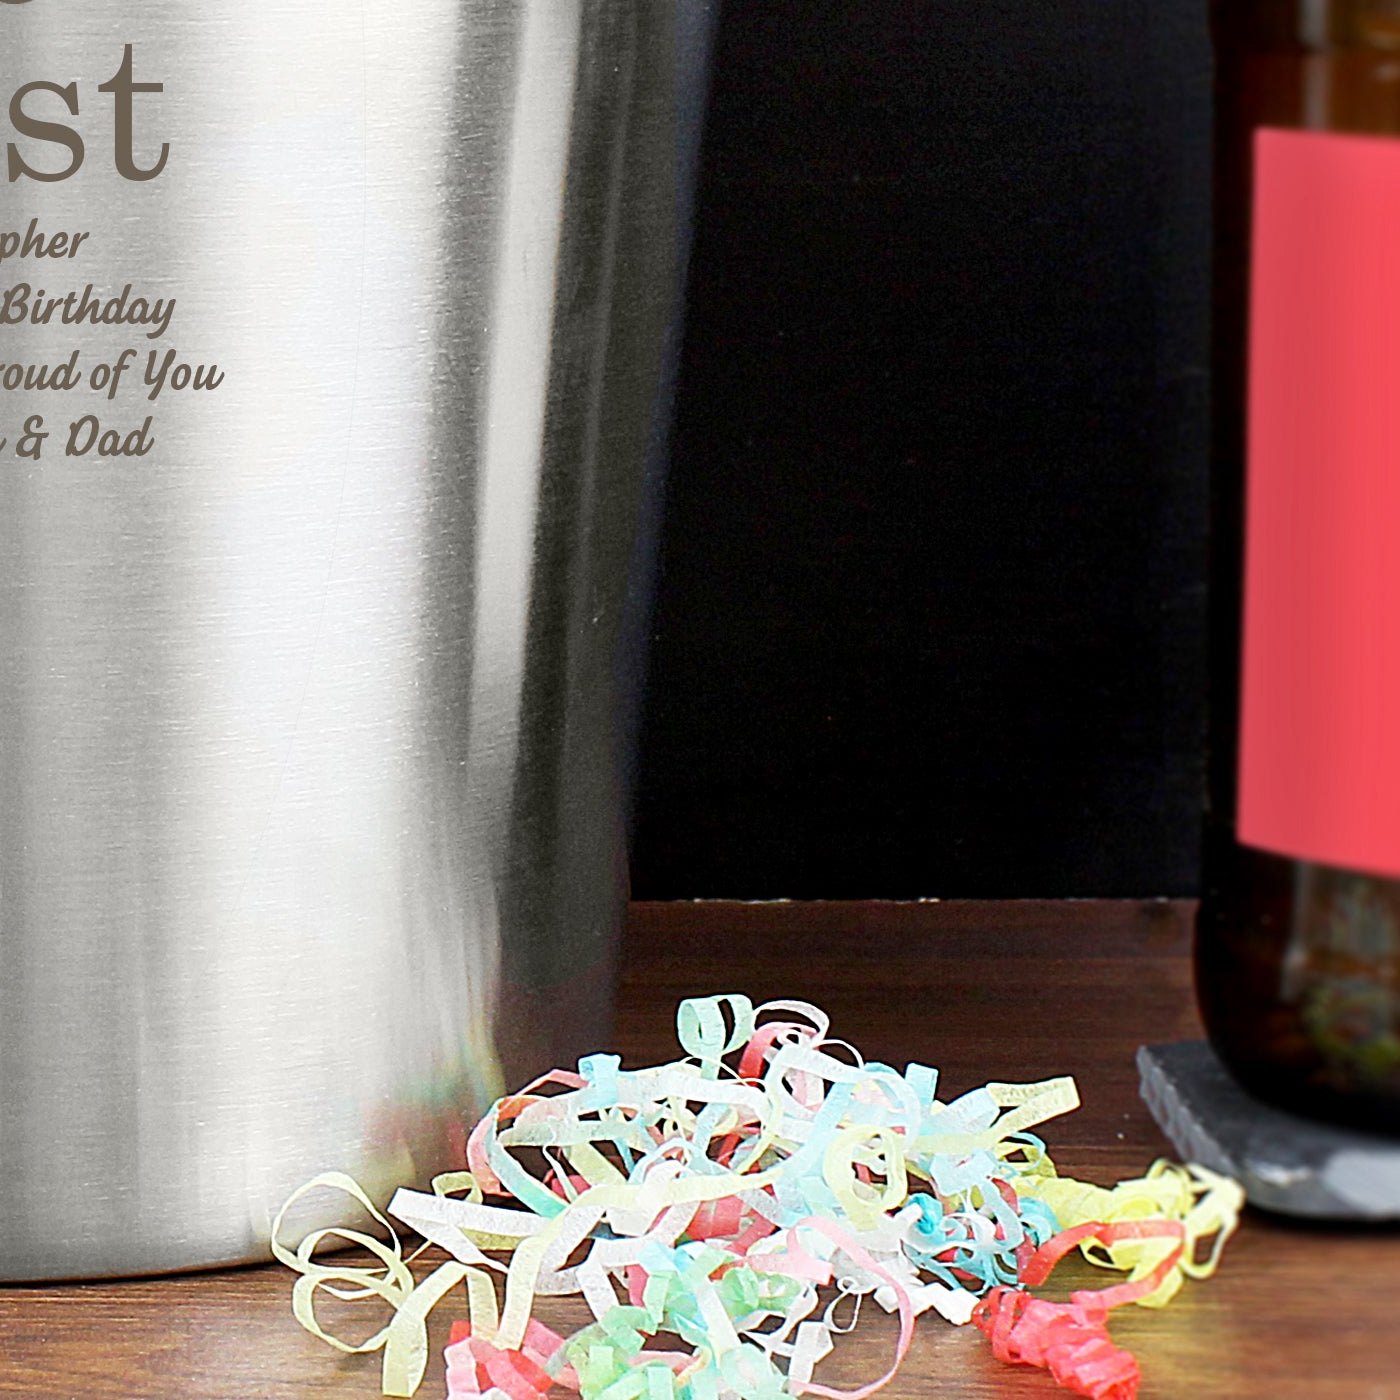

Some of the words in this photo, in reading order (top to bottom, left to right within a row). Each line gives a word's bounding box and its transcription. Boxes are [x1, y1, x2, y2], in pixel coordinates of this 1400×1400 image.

[89, 348, 138, 400] of
[144, 348, 225, 401] You
[15, 414, 50, 461] &
[65, 414, 155, 457] Dad
